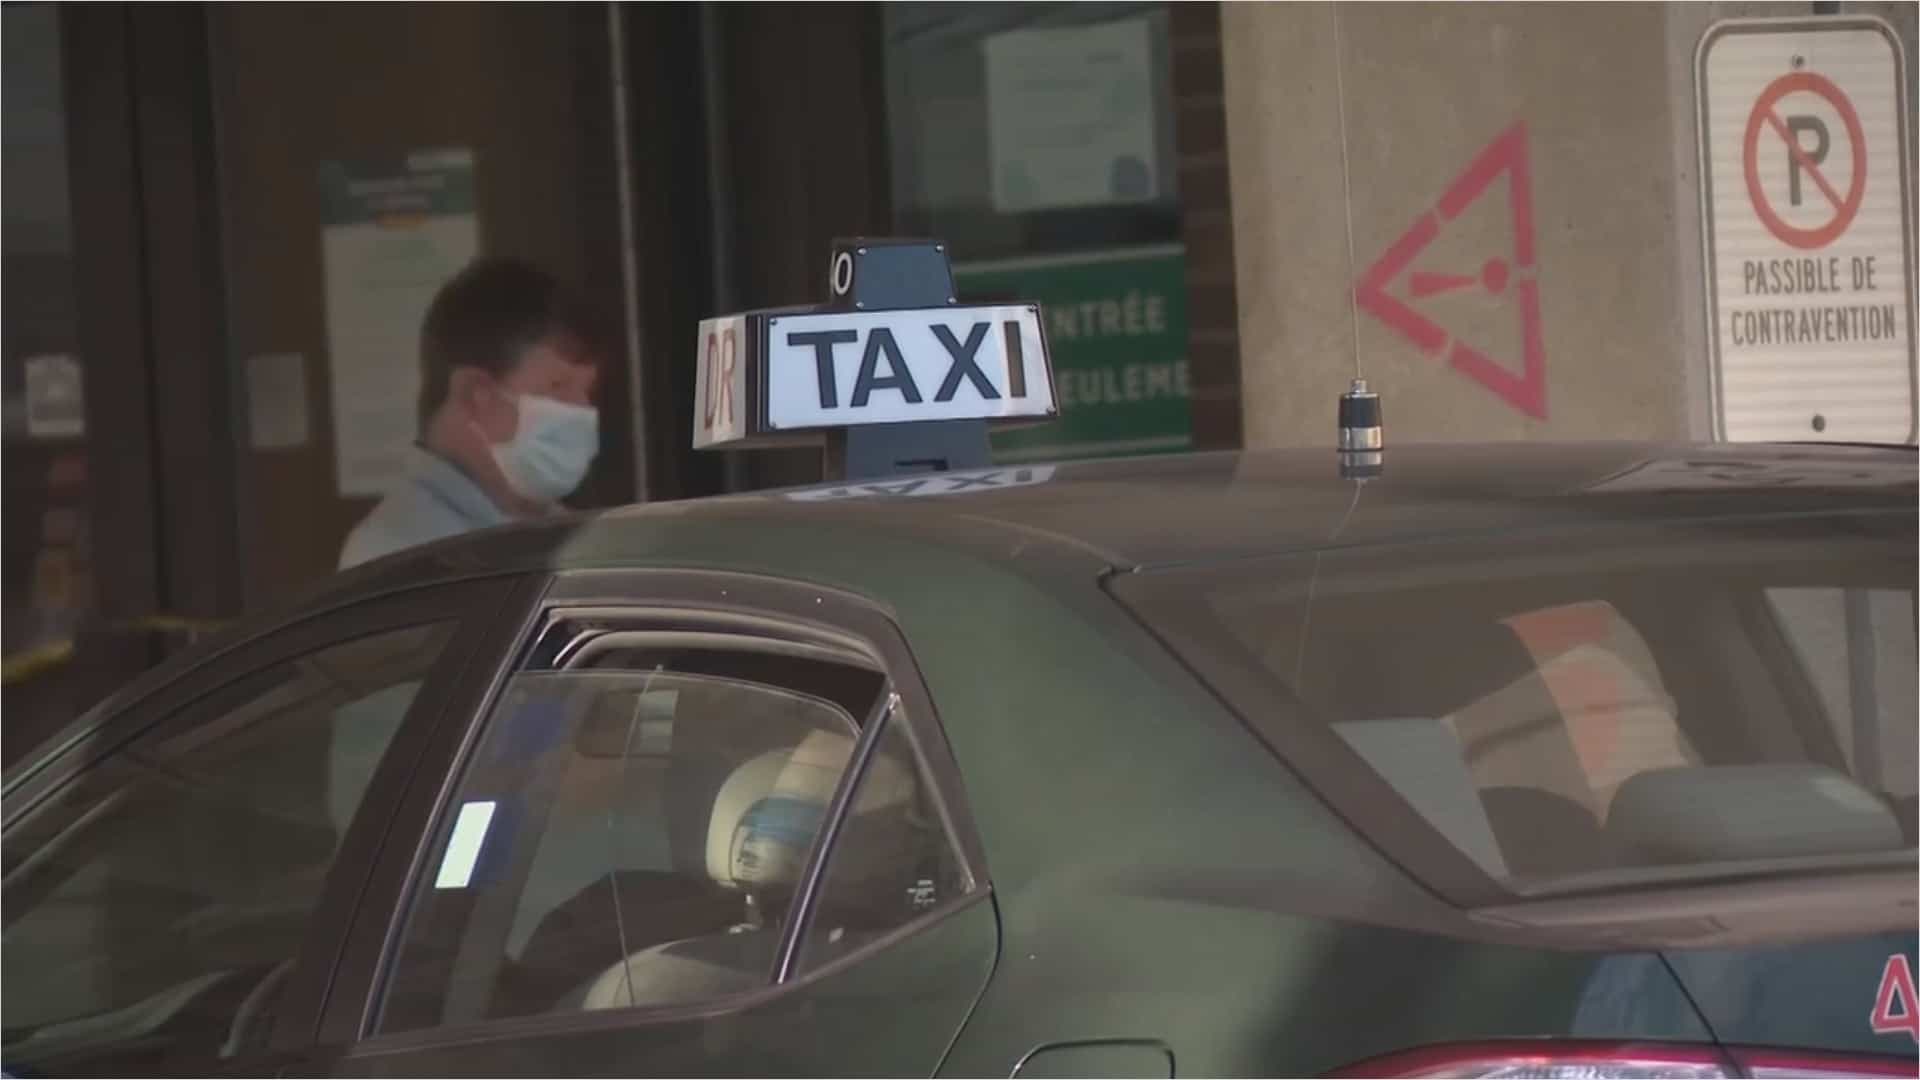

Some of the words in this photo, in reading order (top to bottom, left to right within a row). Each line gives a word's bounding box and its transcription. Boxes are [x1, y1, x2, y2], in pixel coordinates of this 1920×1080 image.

[1744, 256, 1841, 295] PASSIBLE
[1852, 255, 1877, 291] DE
[1731, 304, 1896, 346] CONTRAVENTION
[704, 328, 736, 431] DR
[787, 320, 1027, 409] TAXI
[1058, 359, 1192, 408] EULEME
